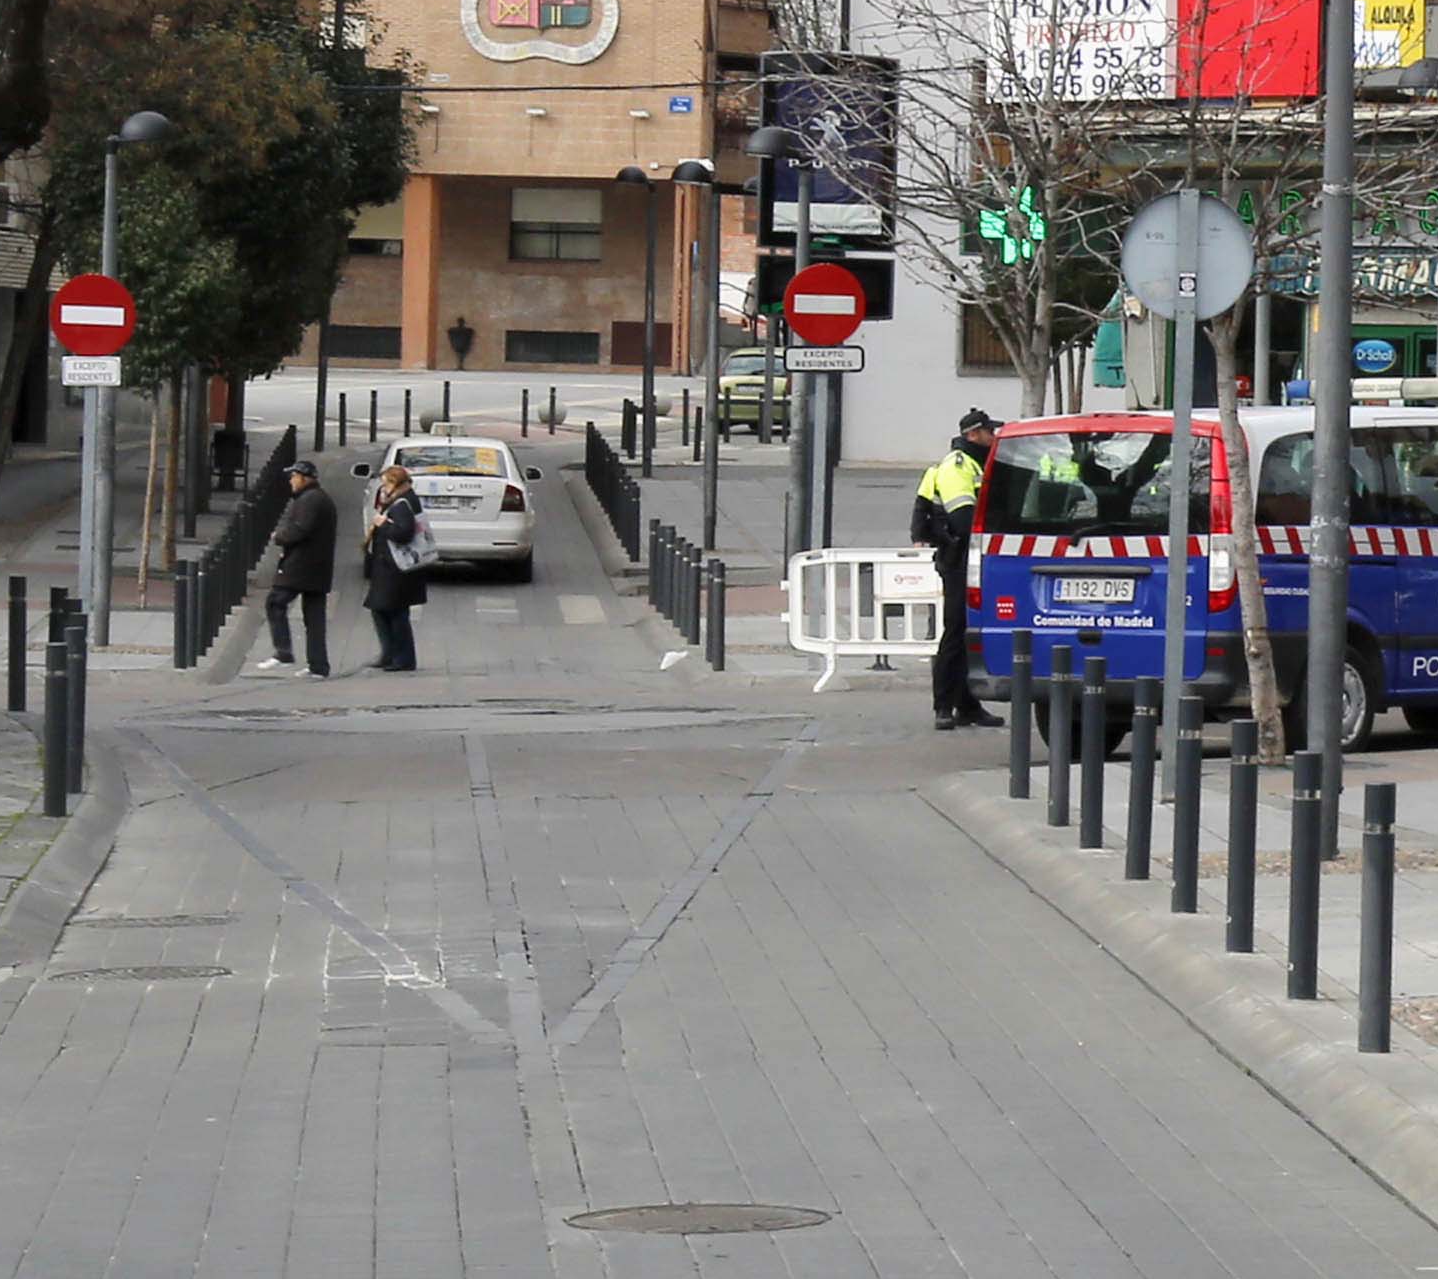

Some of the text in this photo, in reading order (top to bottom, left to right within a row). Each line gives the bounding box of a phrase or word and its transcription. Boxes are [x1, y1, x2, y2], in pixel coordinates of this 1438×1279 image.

[1094, 47, 1123, 69] 55
[1033, 614, 1153, 627] Comunidad de Madrid
